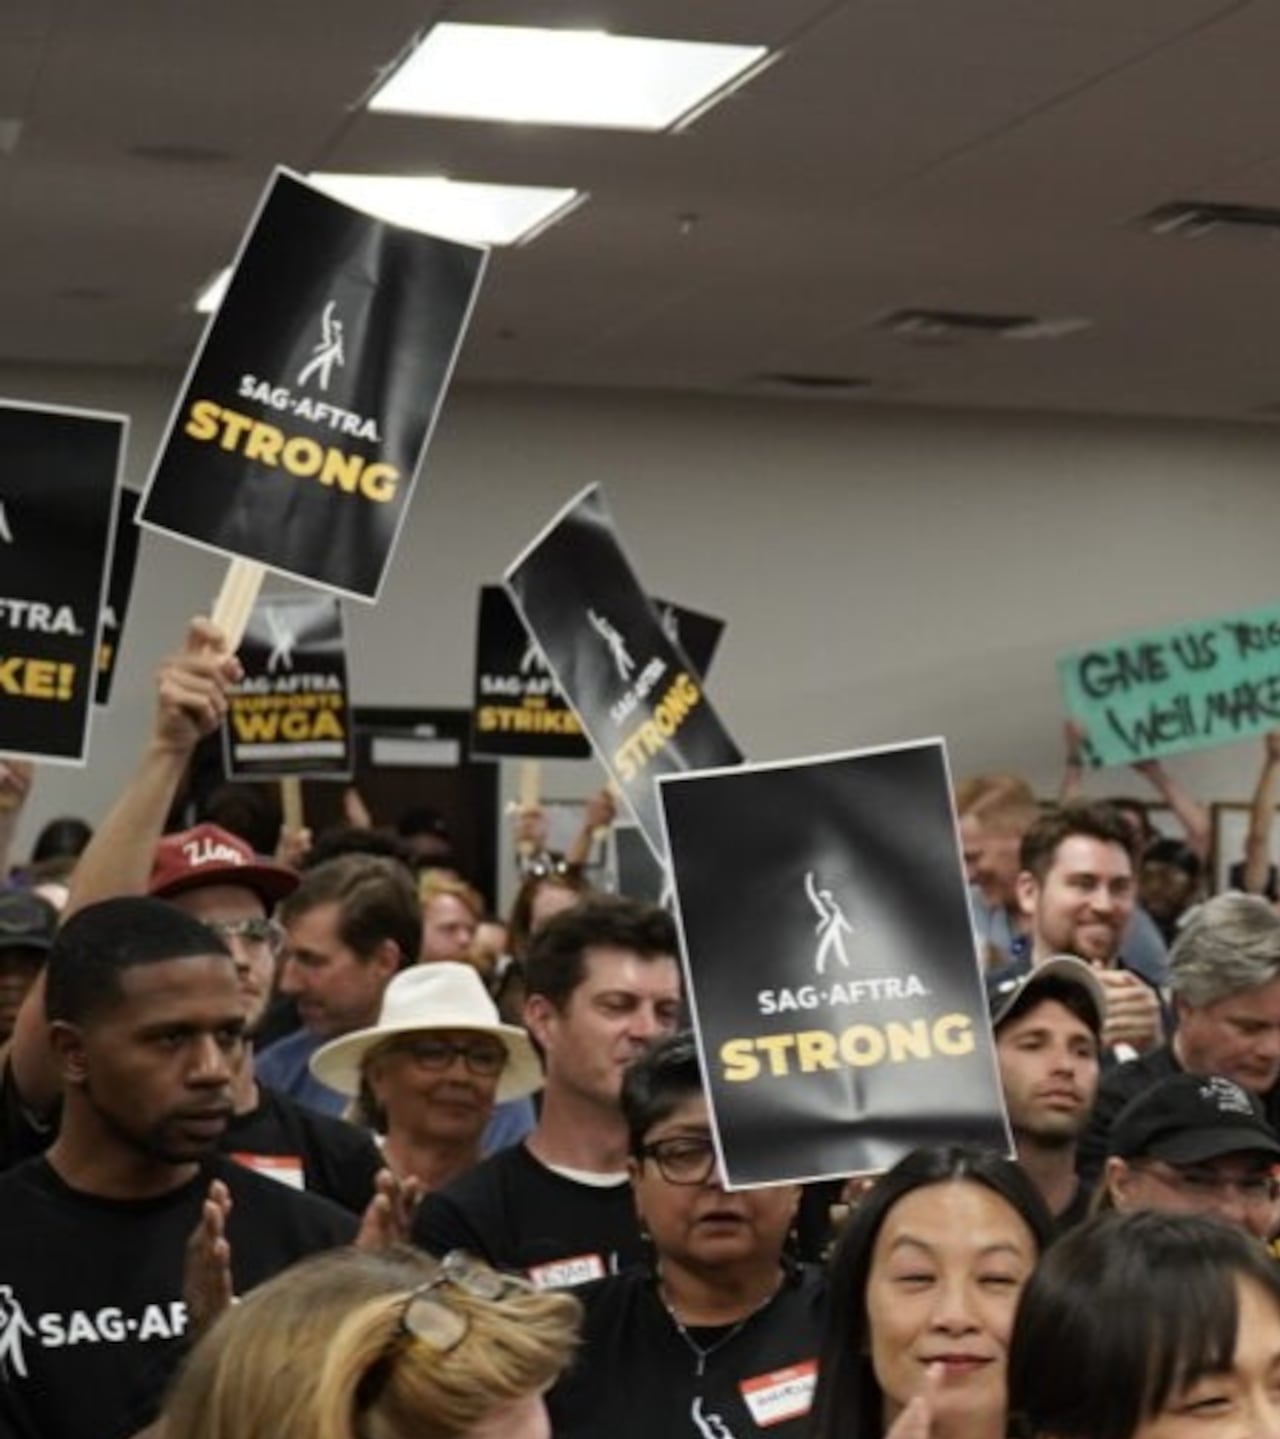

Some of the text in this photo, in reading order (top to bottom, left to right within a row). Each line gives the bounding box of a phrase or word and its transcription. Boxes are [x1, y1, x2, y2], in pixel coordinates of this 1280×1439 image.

[238, 373, 379, 443] SAG·AFTRA
[184, 400, 400, 503] STRONG
[1078, 643, 1171, 700] GIVE
[1171, 631, 1219, 672] US
[233, 710, 345, 741] WGA
[613, 672, 699, 782] STRONG
[757, 973, 926, 1015] SAG·AFTRA
[720, 1012, 976, 1082] STRONG
